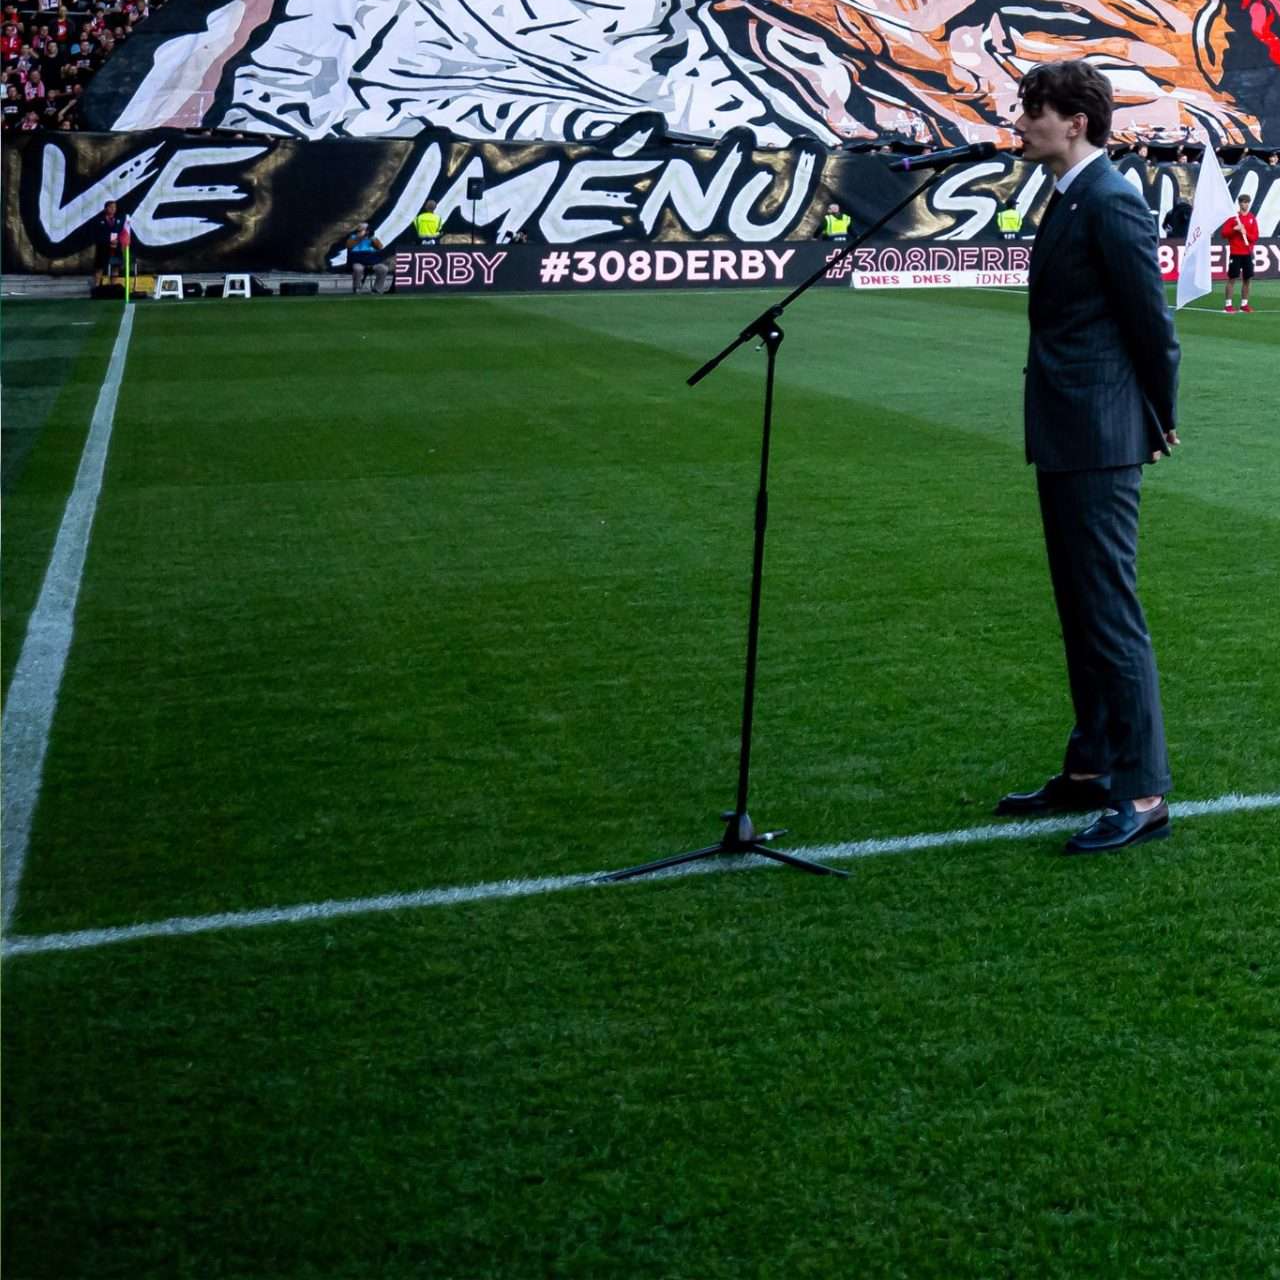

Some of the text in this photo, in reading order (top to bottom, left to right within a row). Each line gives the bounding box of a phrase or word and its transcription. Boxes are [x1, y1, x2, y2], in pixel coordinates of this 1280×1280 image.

[38, 141, 270, 247] VE
[540, 249, 796, 284] #308DERBY
[826, 247, 1034, 278] #308DERB
[860, 273, 1029, 285] DNES DNES iDNES.
